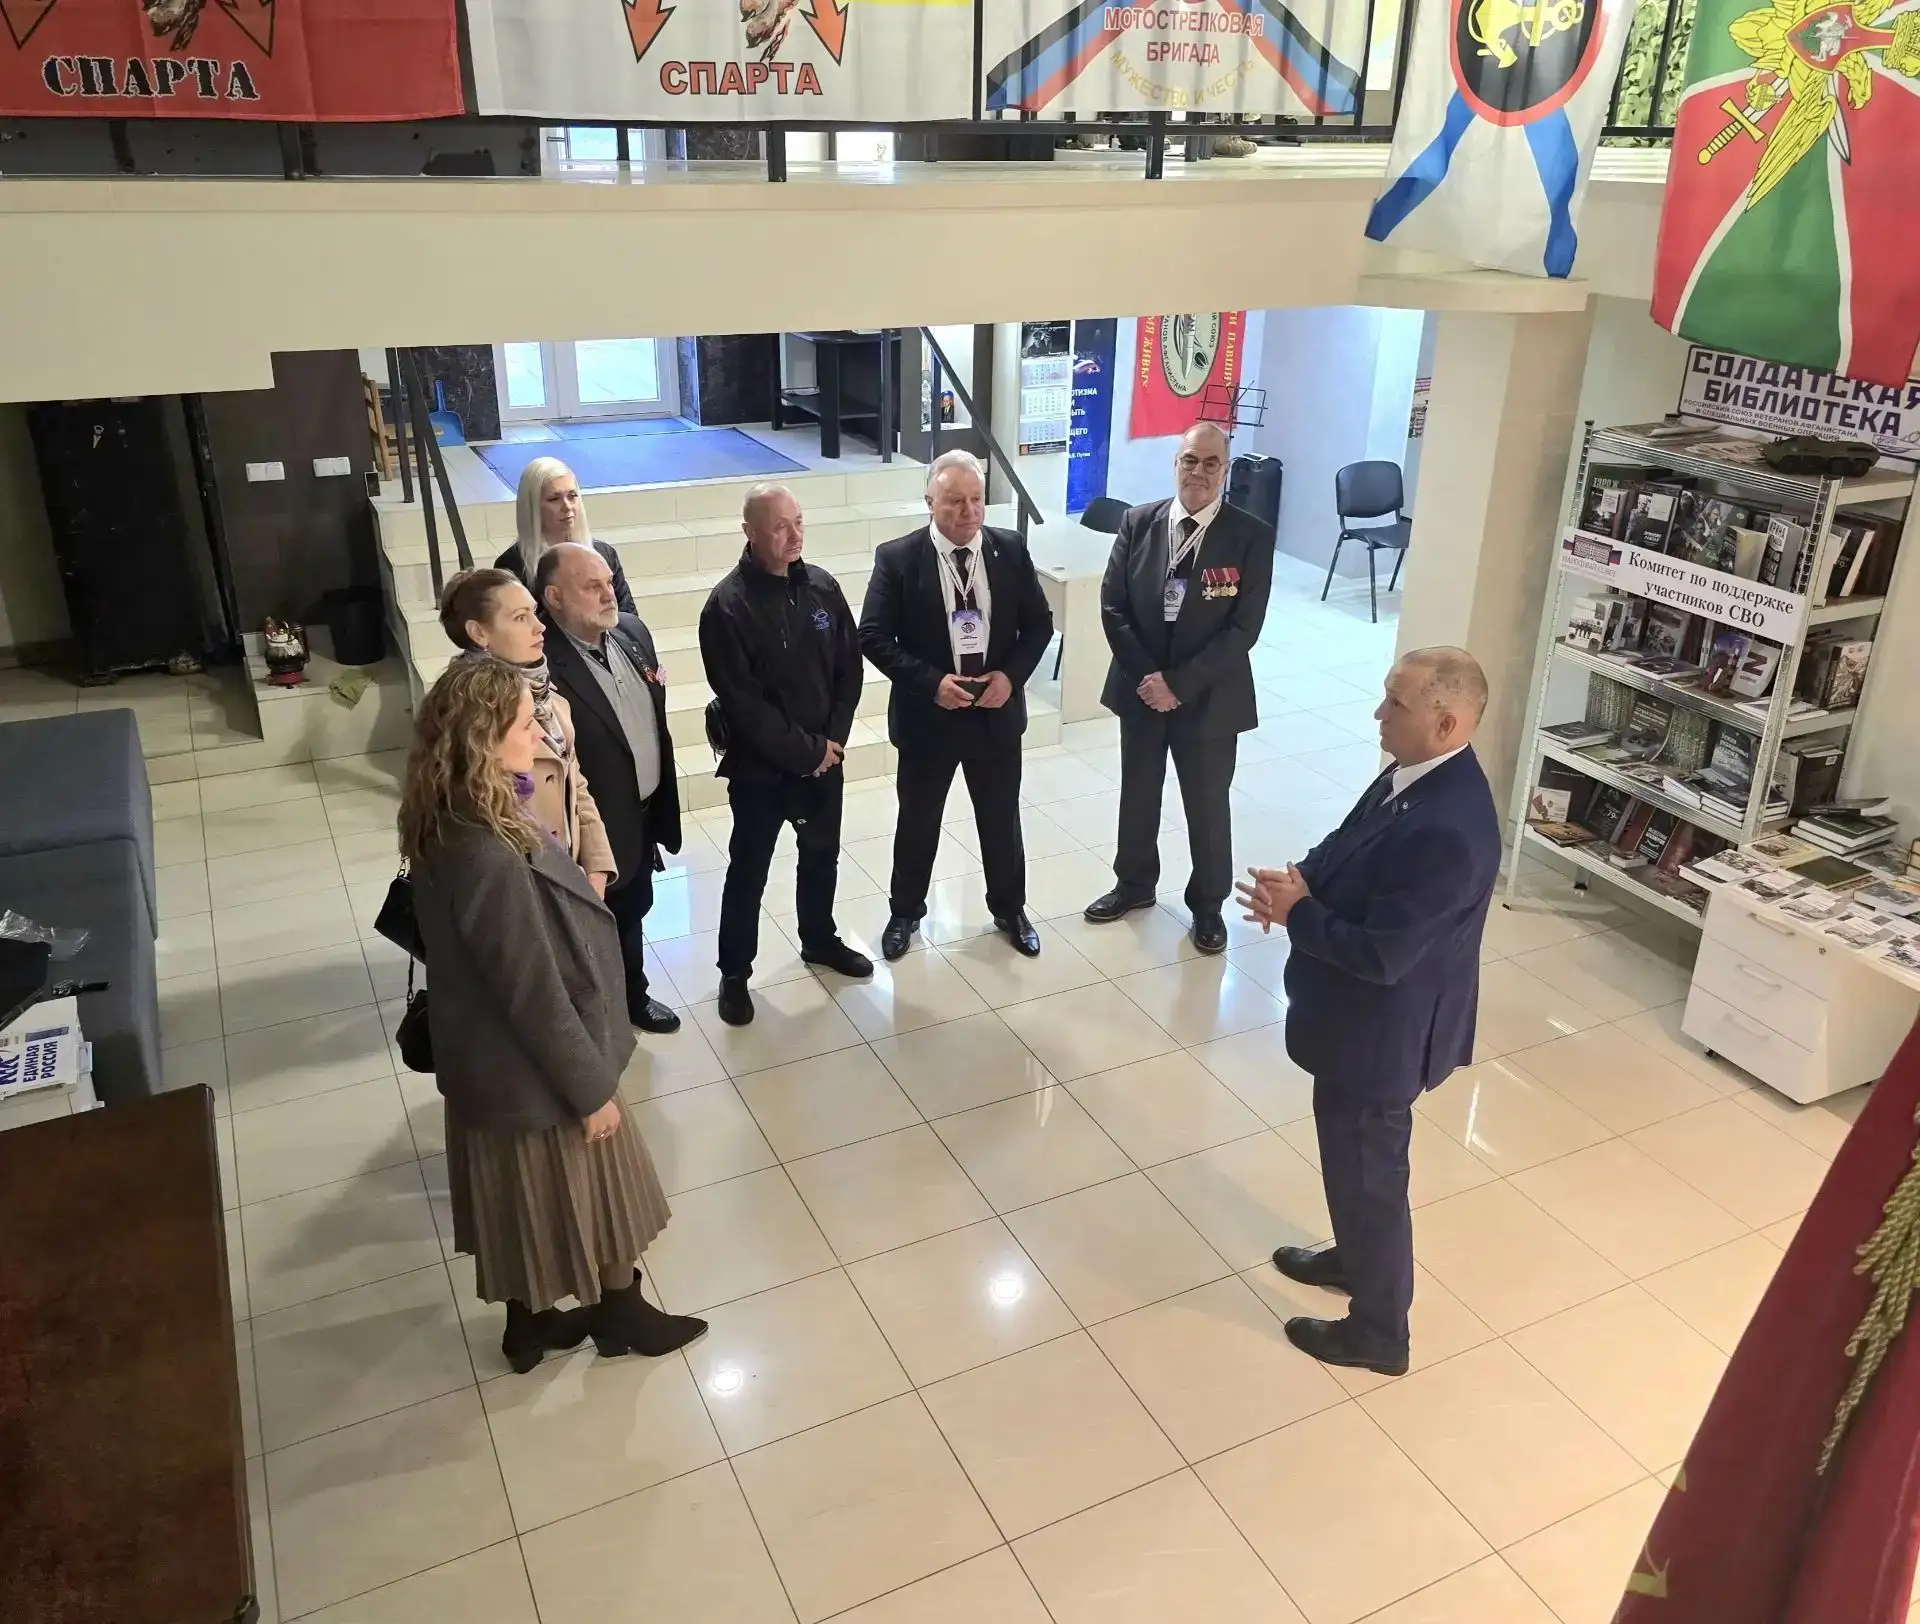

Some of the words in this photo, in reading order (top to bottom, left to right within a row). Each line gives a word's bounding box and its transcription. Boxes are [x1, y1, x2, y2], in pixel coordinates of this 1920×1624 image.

[1104, 7, 1265, 36] МОТОСТРЕЛКОВАЯ
[1146, 41, 1221, 67] БРИГАДА
[42, 55, 261, 101] СПАРТА
[659, 60, 824, 96] СПАРТА
[1110, 49, 1189, 107] МУЖЕСТВО
[1194, 90, 1204, 105] И
[1141, 337, 1153, 388] ЖИВЫХ
[1684, 398, 1731, 415] РОССИЙСКИЙ
[1731, 408, 1753, 418] СОЮЗ
[1754, 411, 1799, 427] ВЕТЕРАНОВ
[1800, 421, 1858, 439] АФГАНИСТАНА
[1702, 409, 1757, 426] СПЕЦИАЛЬНЫХ
[1758, 420, 1796, 433] ВОЕННЫХ
[1704, 379, 1901, 437] БИБЛИОТЕКА
[1628, 550, 1686, 581] Комитет
[1690, 573, 1707, 588] по
[1712, 580, 1794, 615] поддержке
[1644, 581, 1724, 615] участников
[1728, 604, 1765, 628] СВО
[23, 1044, 40, 1083] ЕДИНАЯ
[41, 1040, 58, 1080] РОССИЯ
